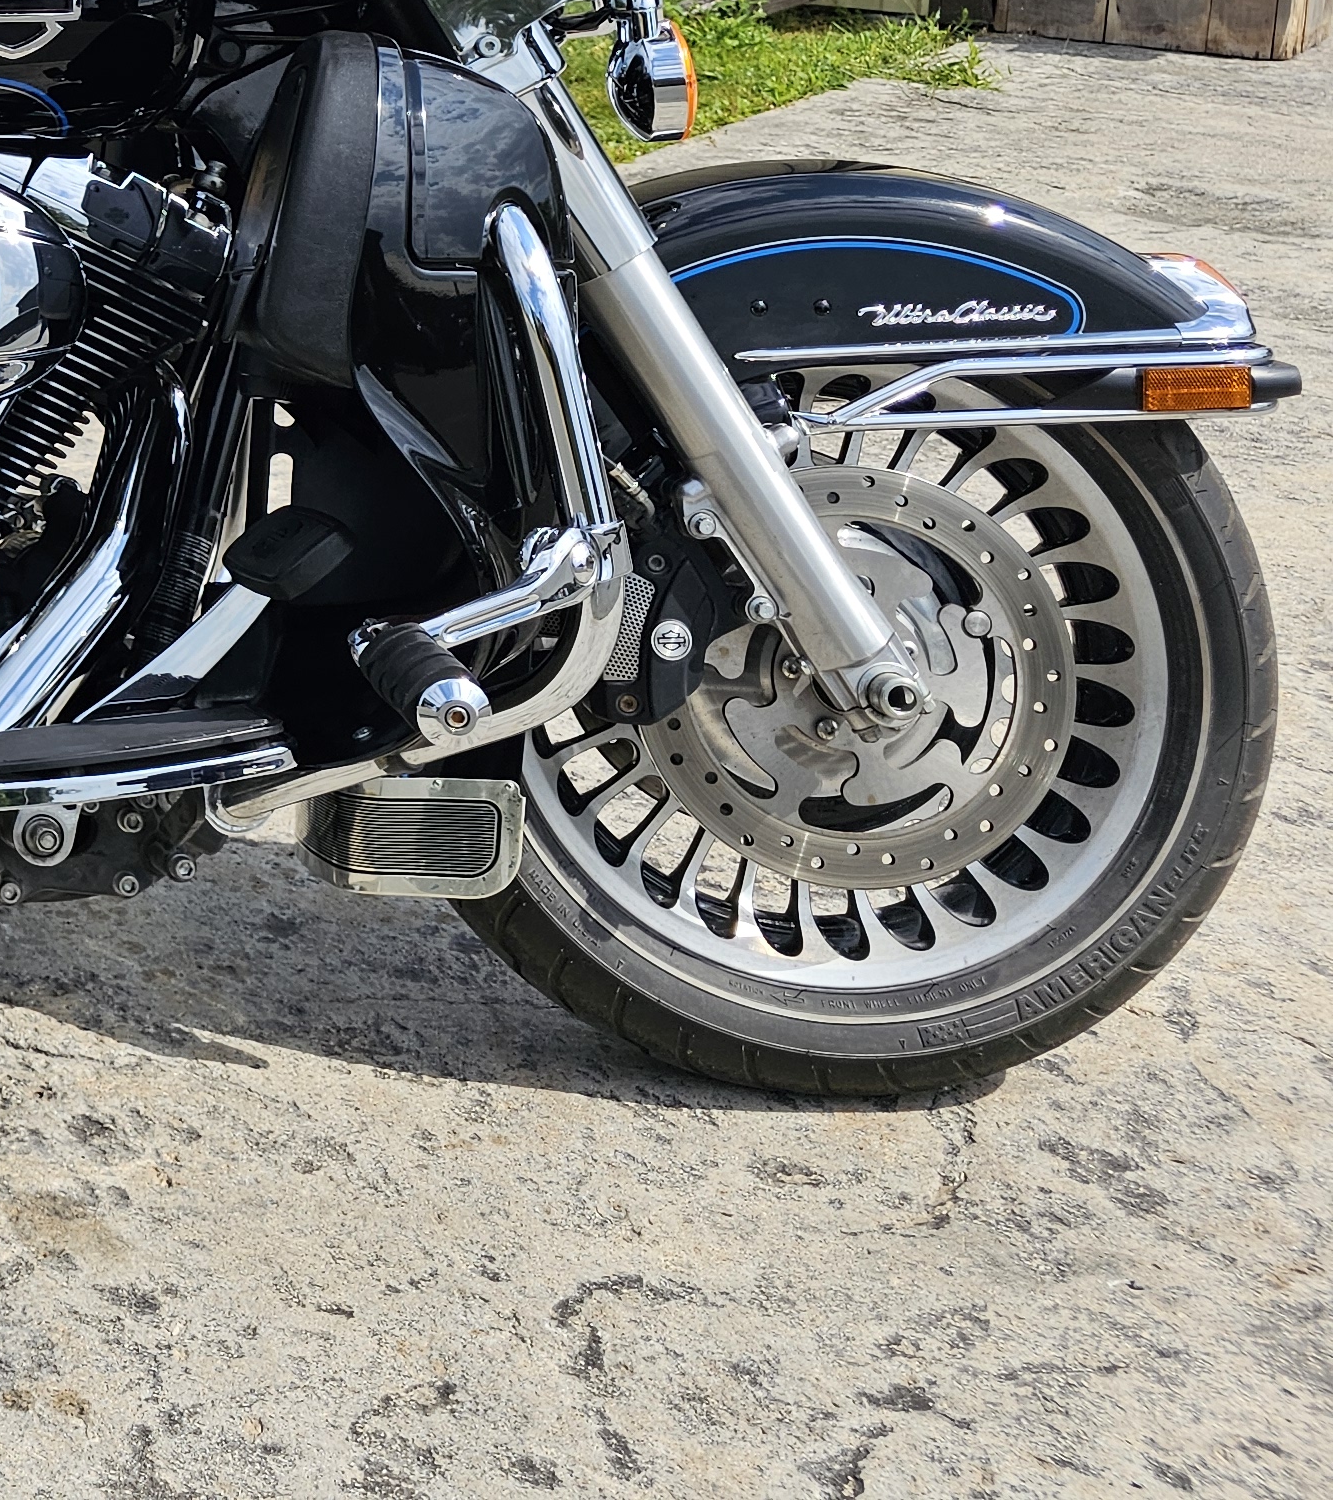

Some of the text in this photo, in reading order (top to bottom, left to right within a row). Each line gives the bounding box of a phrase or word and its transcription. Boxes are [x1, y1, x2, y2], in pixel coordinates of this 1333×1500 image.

[528, 868, 557, 903] MADE
[557, 903, 571, 919] IN
[1014, 884, 1178, 1023] AMERICAN
[959, 975, 988, 993] ONLY
